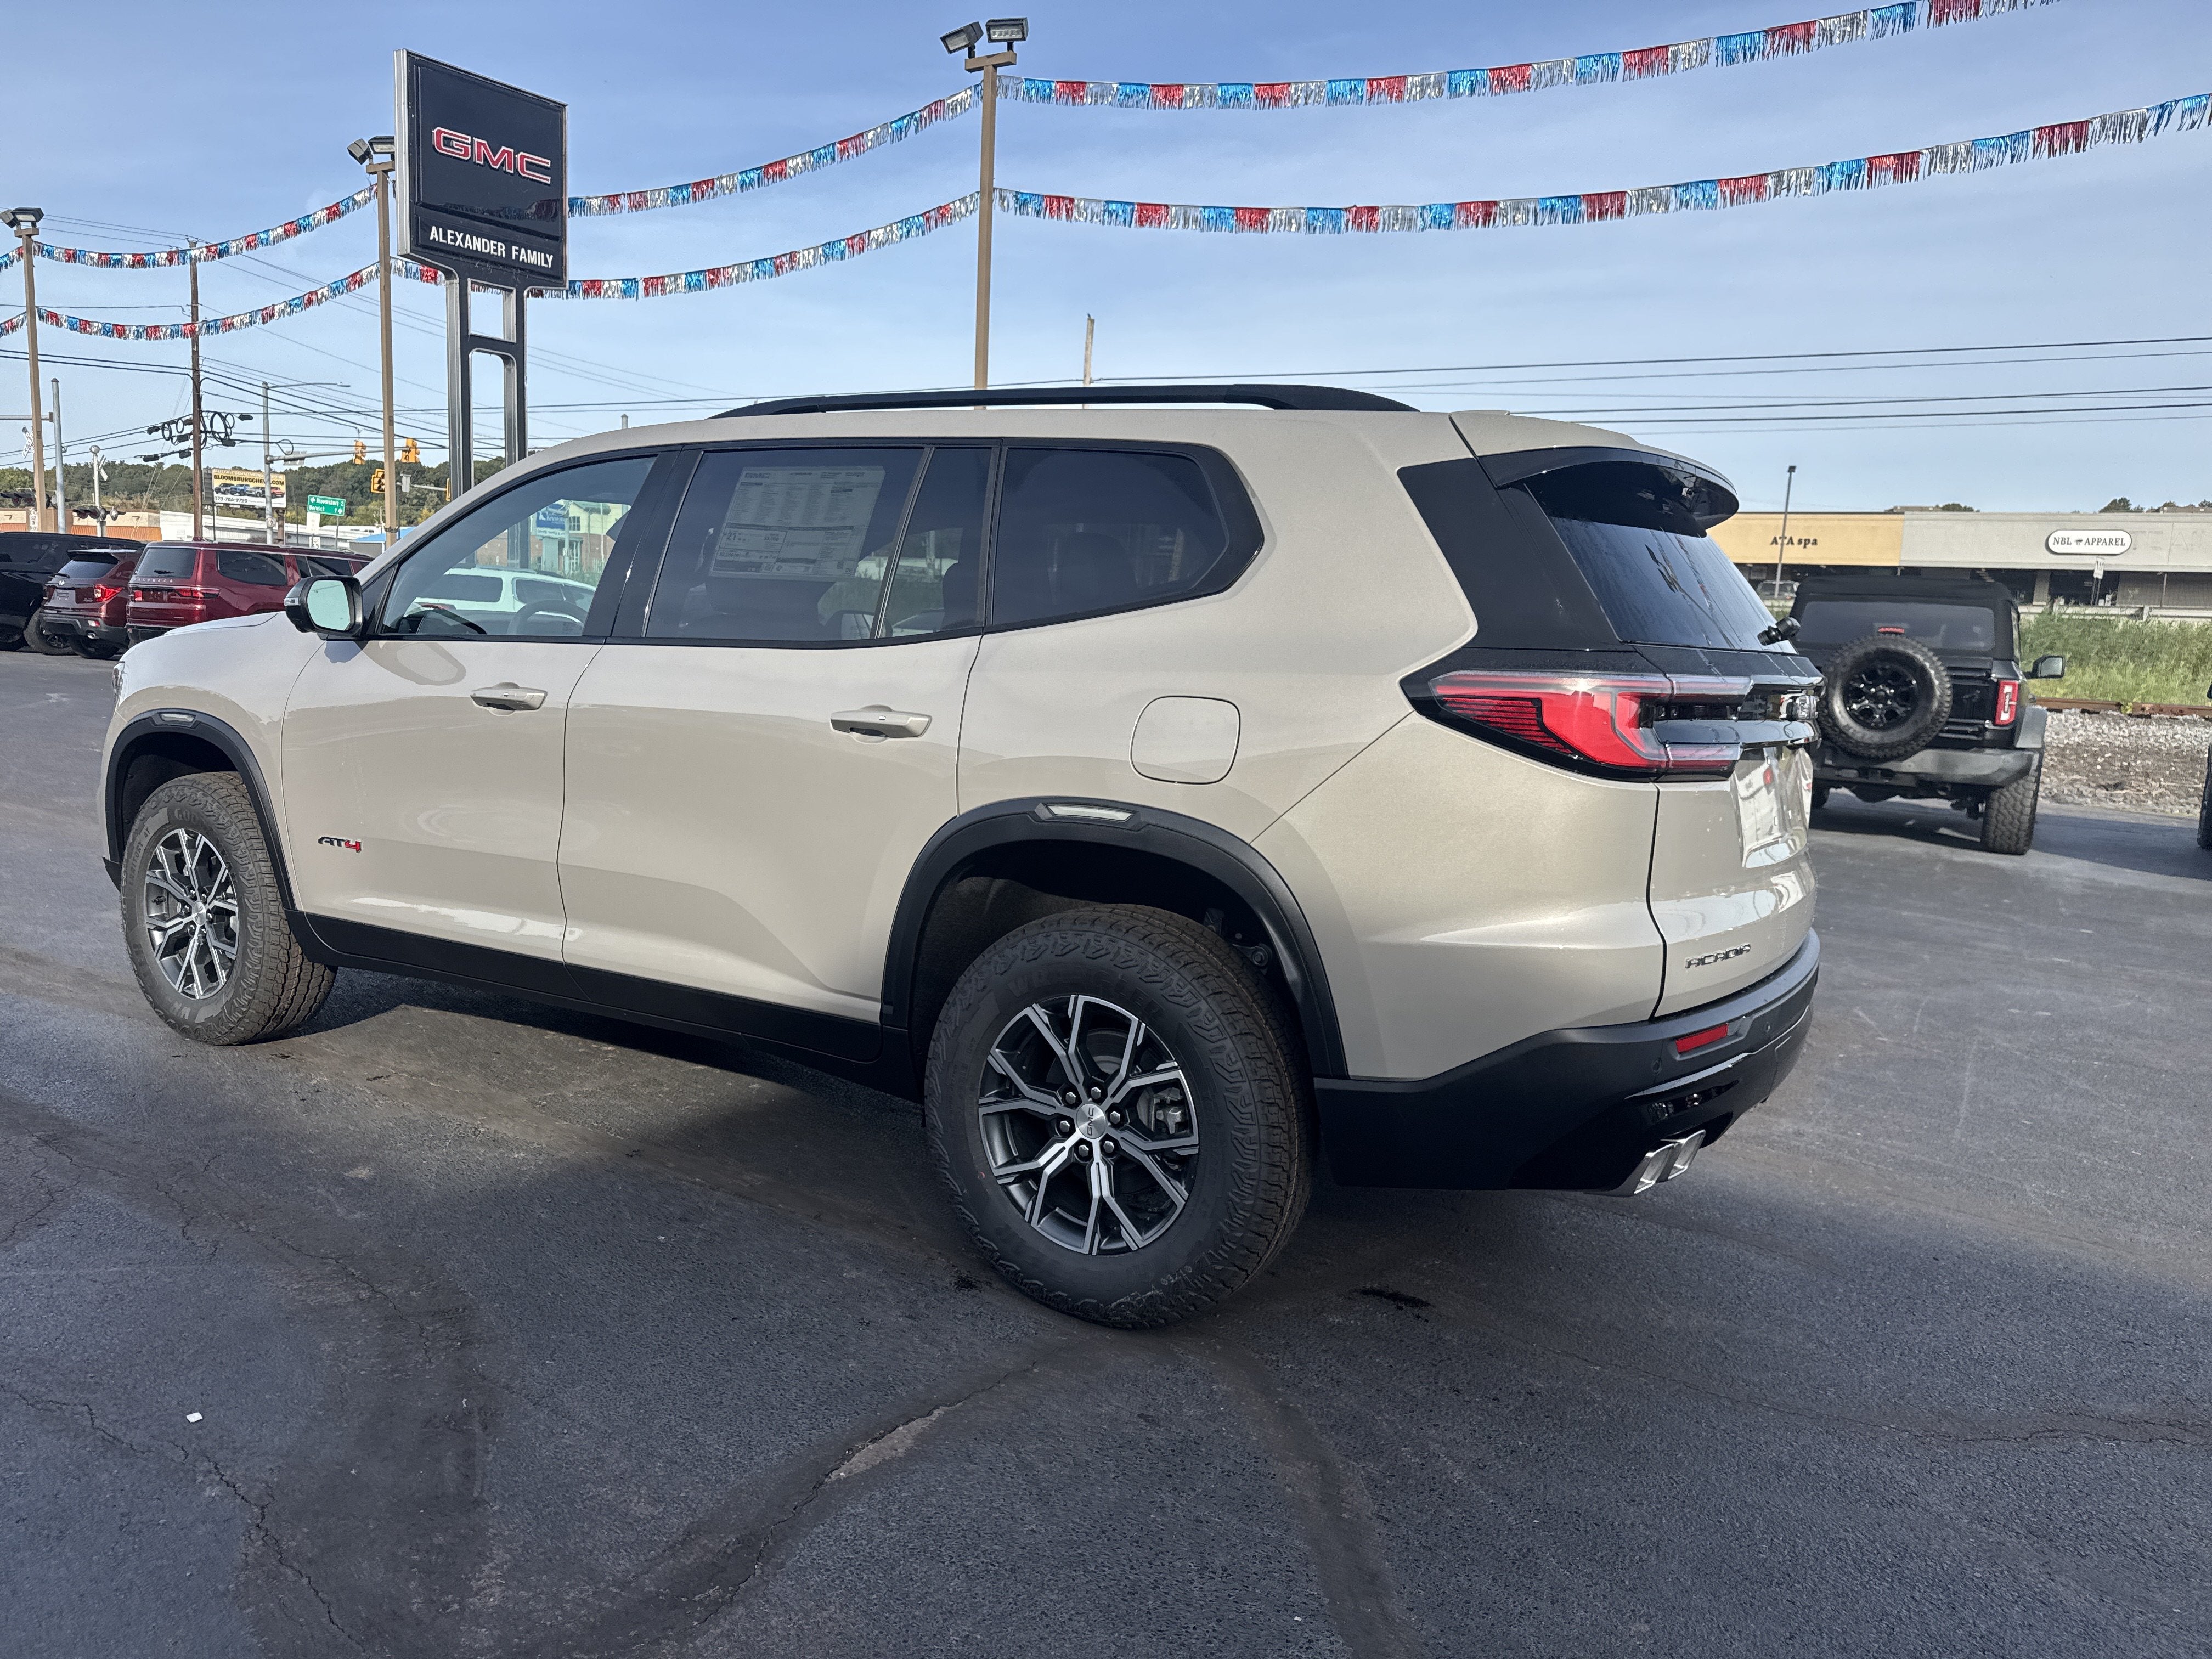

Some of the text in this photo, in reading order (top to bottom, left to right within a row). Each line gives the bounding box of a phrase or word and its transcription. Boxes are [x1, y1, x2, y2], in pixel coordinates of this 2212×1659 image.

[432, 127, 551, 184] GMC
[430, 225, 553, 268] ALEXANDER FAMILY
[214, 475, 284, 486] BLOOMSBURGCHE.COM
[1797, 538, 1818, 549] spa
[2053, 537, 2072, 546] NBL
[2084, 537, 2126, 546] APPAREL
[318, 836, 362, 854] AT4
[1685, 943, 1751, 969] ACADIA
